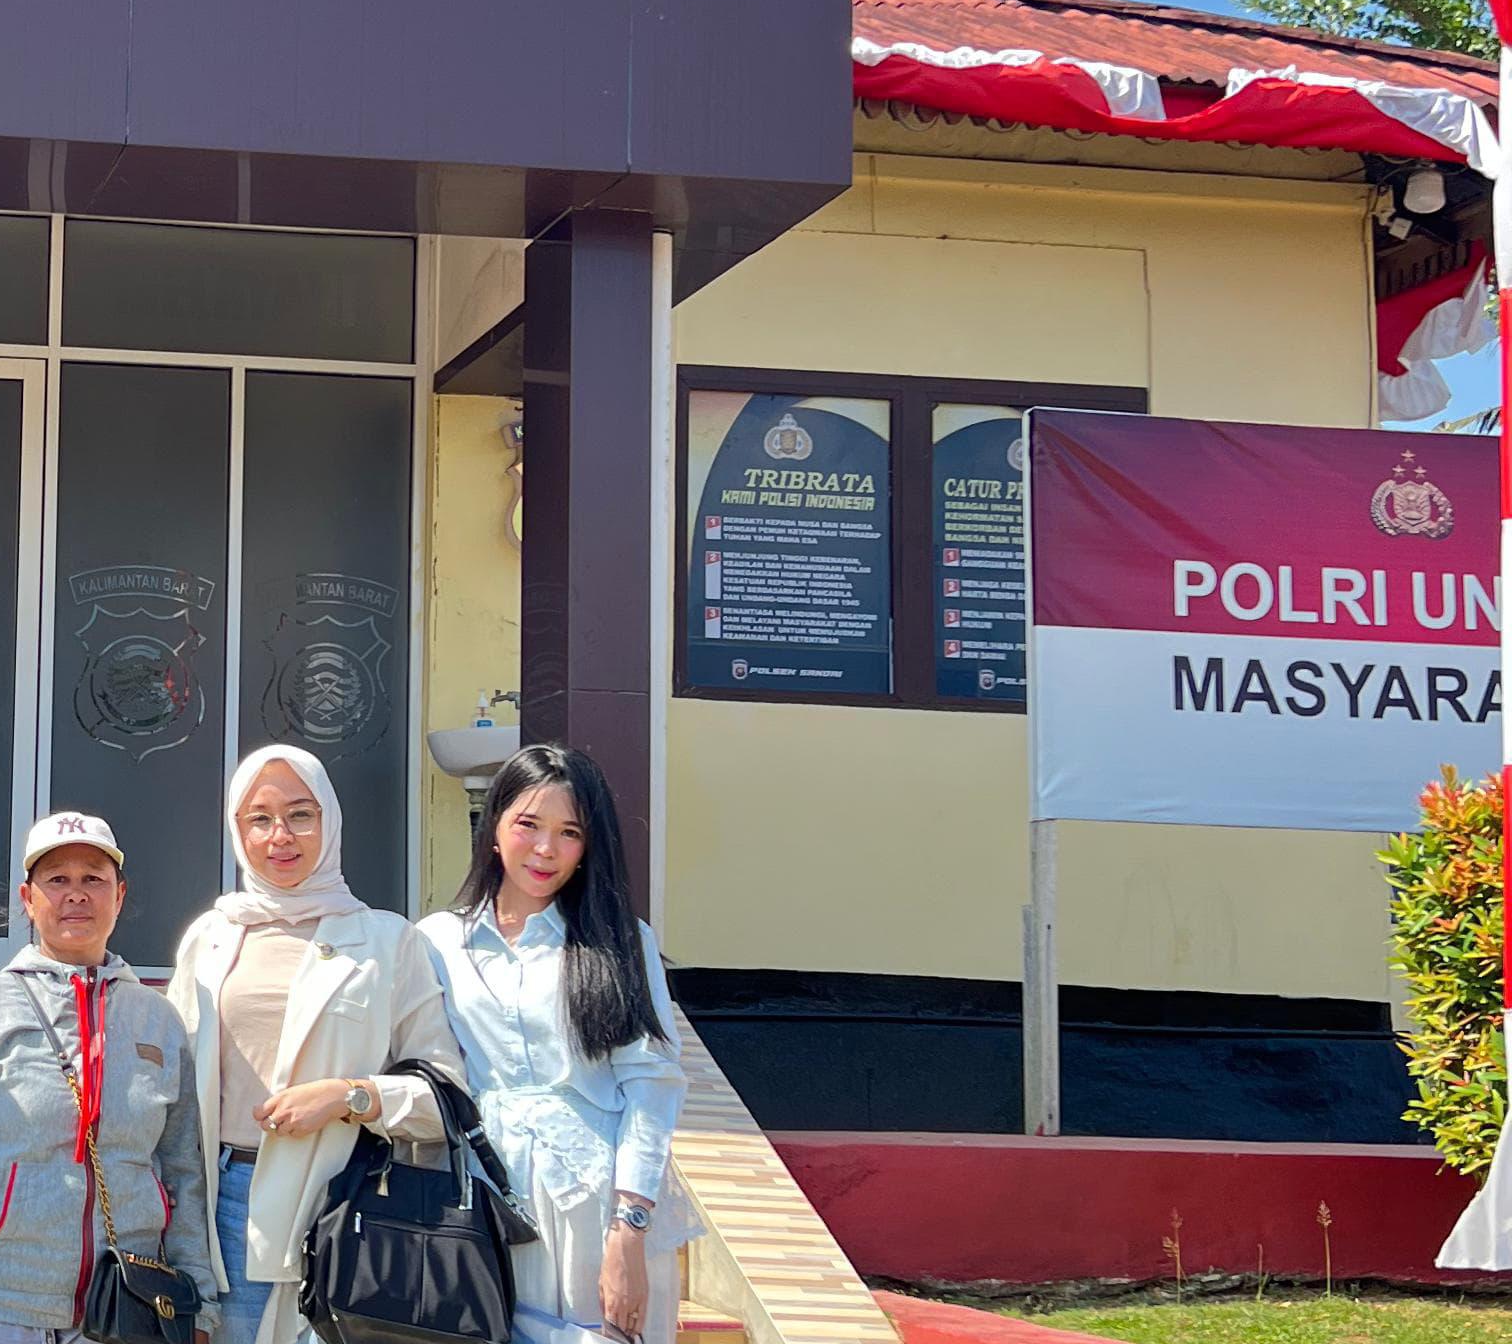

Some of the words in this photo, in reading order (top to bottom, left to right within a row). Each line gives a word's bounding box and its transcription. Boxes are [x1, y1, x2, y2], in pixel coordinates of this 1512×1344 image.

[744, 468, 876, 493] TRIBRATA
[944, 478, 1002, 499] CATUR
[721, 490, 756, 505] KAMI
[759, 492, 803, 507] POLISI
[805, 494, 876, 511] INDONESIA
[79, 574, 159, 595] KALIMANTAN
[163, 577, 206, 597] BART
[1173, 559, 1388, 627] POLRI
[1412, 571, 1501, 632] UN
[348, 586, 392, 608] BARAT
